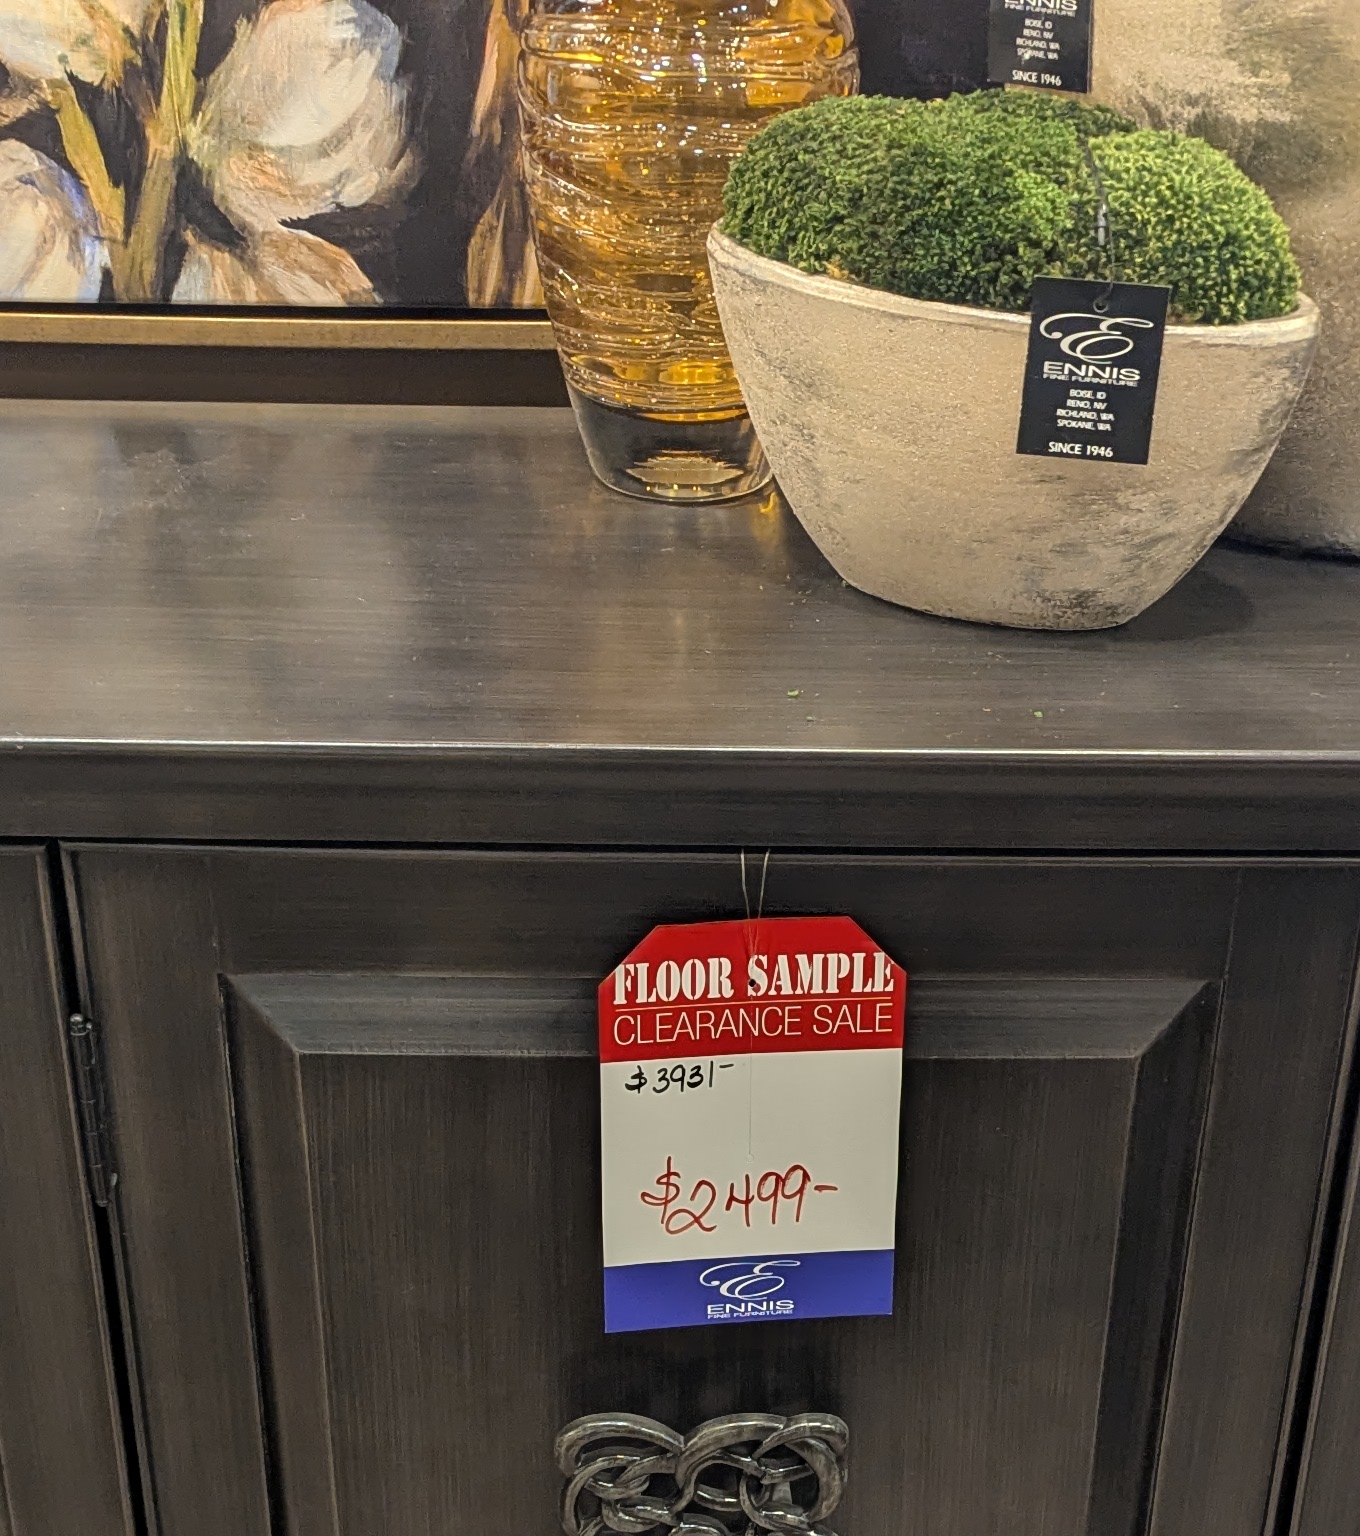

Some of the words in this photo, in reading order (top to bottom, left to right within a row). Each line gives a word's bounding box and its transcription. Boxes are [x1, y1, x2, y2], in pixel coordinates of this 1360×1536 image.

[1012, 69, 1038, 83] SINCE
[1041, 74, 1062, 86] 1946
[1043, 361, 1141, 381] ENNIS
[1048, 441, 1083, 455] SINCE
[1086, 445, 1114, 458] 1946
[613, 956, 735, 1005] FLOOR
[747, 951, 895, 997] SAMPLE
[613, 1004, 803, 1046] CLEARANCE
[812, 1002, 894, 1036] SALE
[707, 1299, 795, 1315] ENNIS
